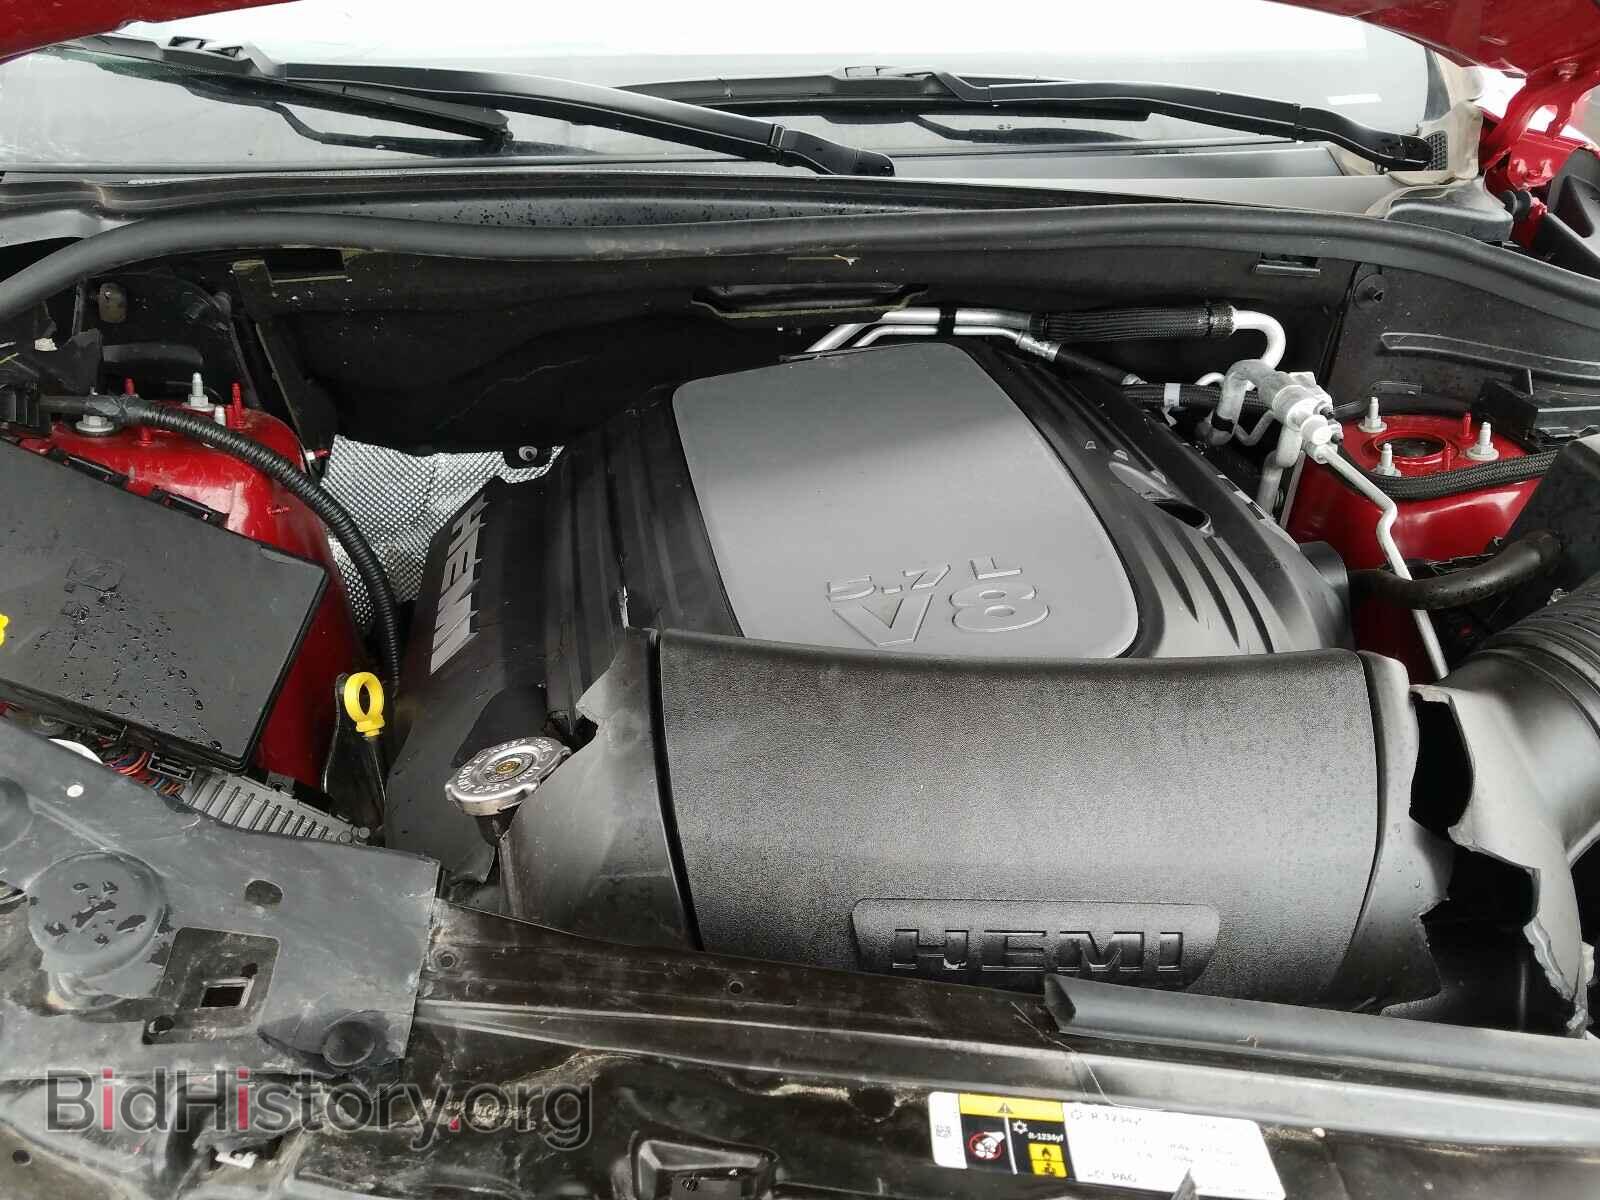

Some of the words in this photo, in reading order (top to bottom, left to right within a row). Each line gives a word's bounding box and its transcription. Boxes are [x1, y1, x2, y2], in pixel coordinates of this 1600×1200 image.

[430, 494, 488, 675] HEMI
[832, 582, 1051, 647] V8
[891, 928, 1184, 972] HEMI
